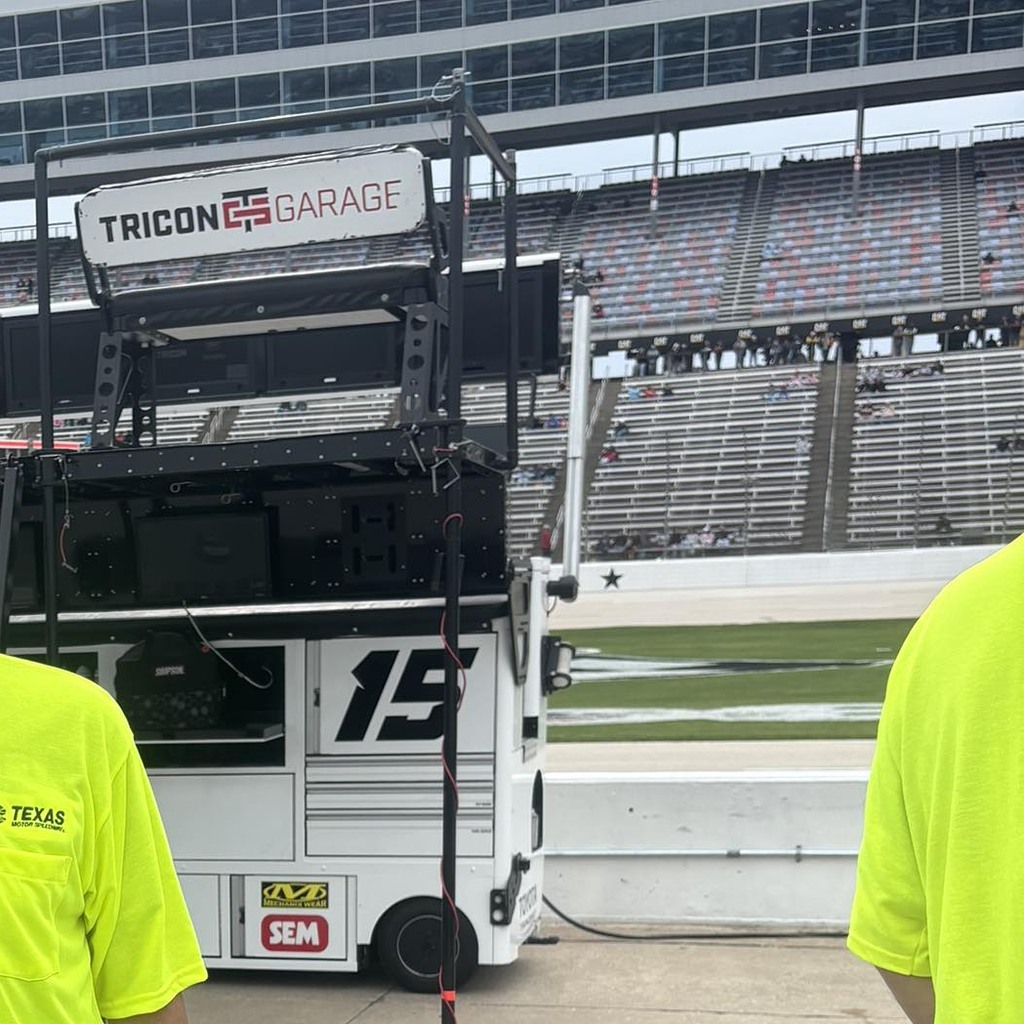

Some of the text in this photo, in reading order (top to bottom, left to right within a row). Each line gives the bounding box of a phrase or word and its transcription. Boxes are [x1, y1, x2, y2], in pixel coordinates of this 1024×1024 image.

[99, 180, 402, 243] TRICON GARAGE
[334, 647, 479, 742] 15
[11, 805, 65, 825] TEXAS
[269, 921, 320, 946] SEM
